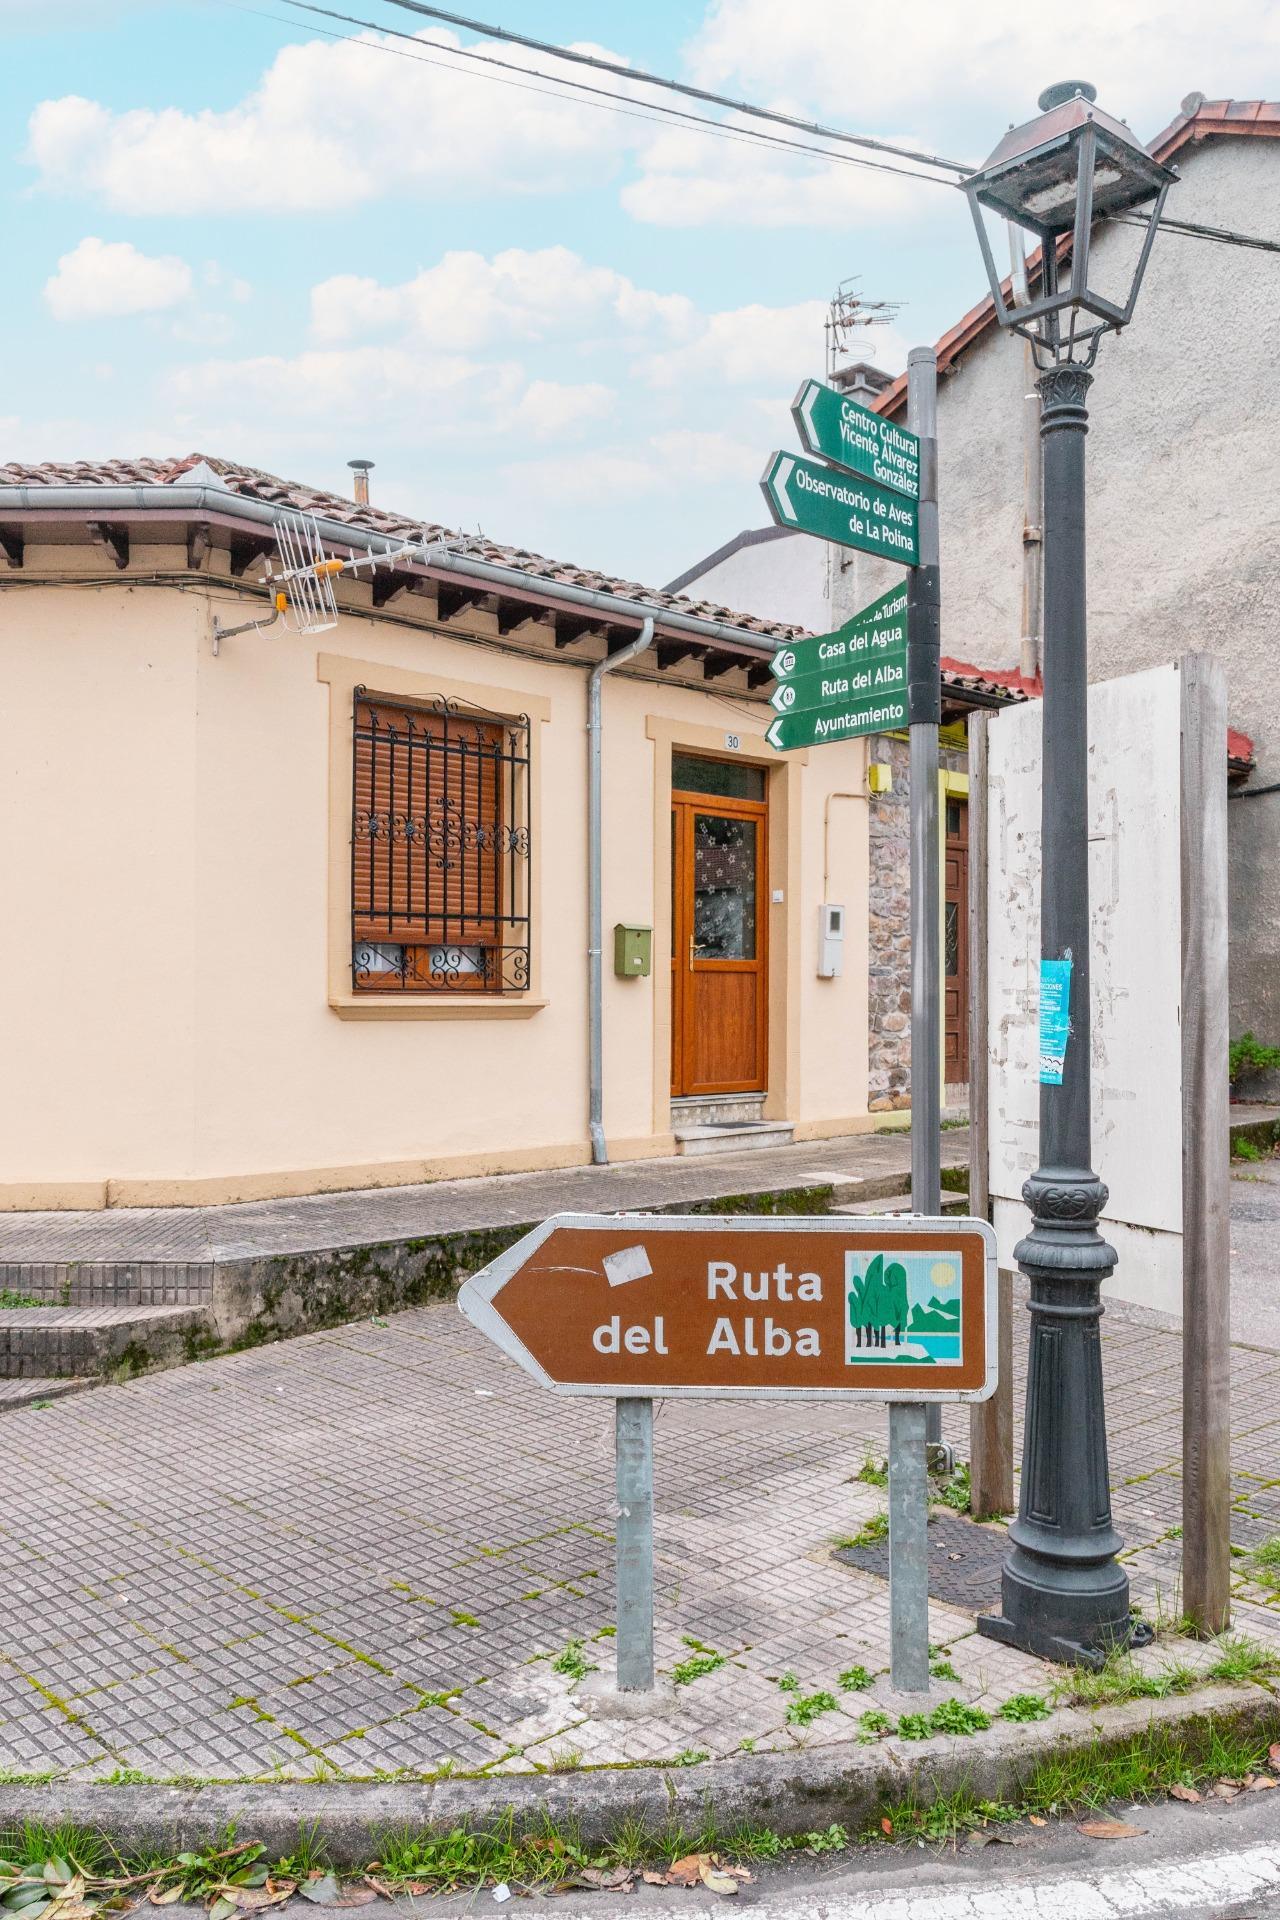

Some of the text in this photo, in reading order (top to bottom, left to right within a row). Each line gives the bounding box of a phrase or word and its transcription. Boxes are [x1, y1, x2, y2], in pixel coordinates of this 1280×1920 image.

[839, 420, 918, 476] Vicente Álvarez
[841, 402, 918, 458] Centro Cultural
[873, 461, 918, 496] González
[795, 469, 913, 527] Observatorio de Aves
[849, 514, 914, 551] de La Polina
[818, 626, 902, 660] Casa del Agua
[821, 665, 903, 697] Ruta del Alba
[814, 704, 904, 736] Ayuntamiento
[727, 735, 739, 749] 30
[706, 1261, 824, 1303] Ruta
[592, 1315, 822, 1358] del Alba
